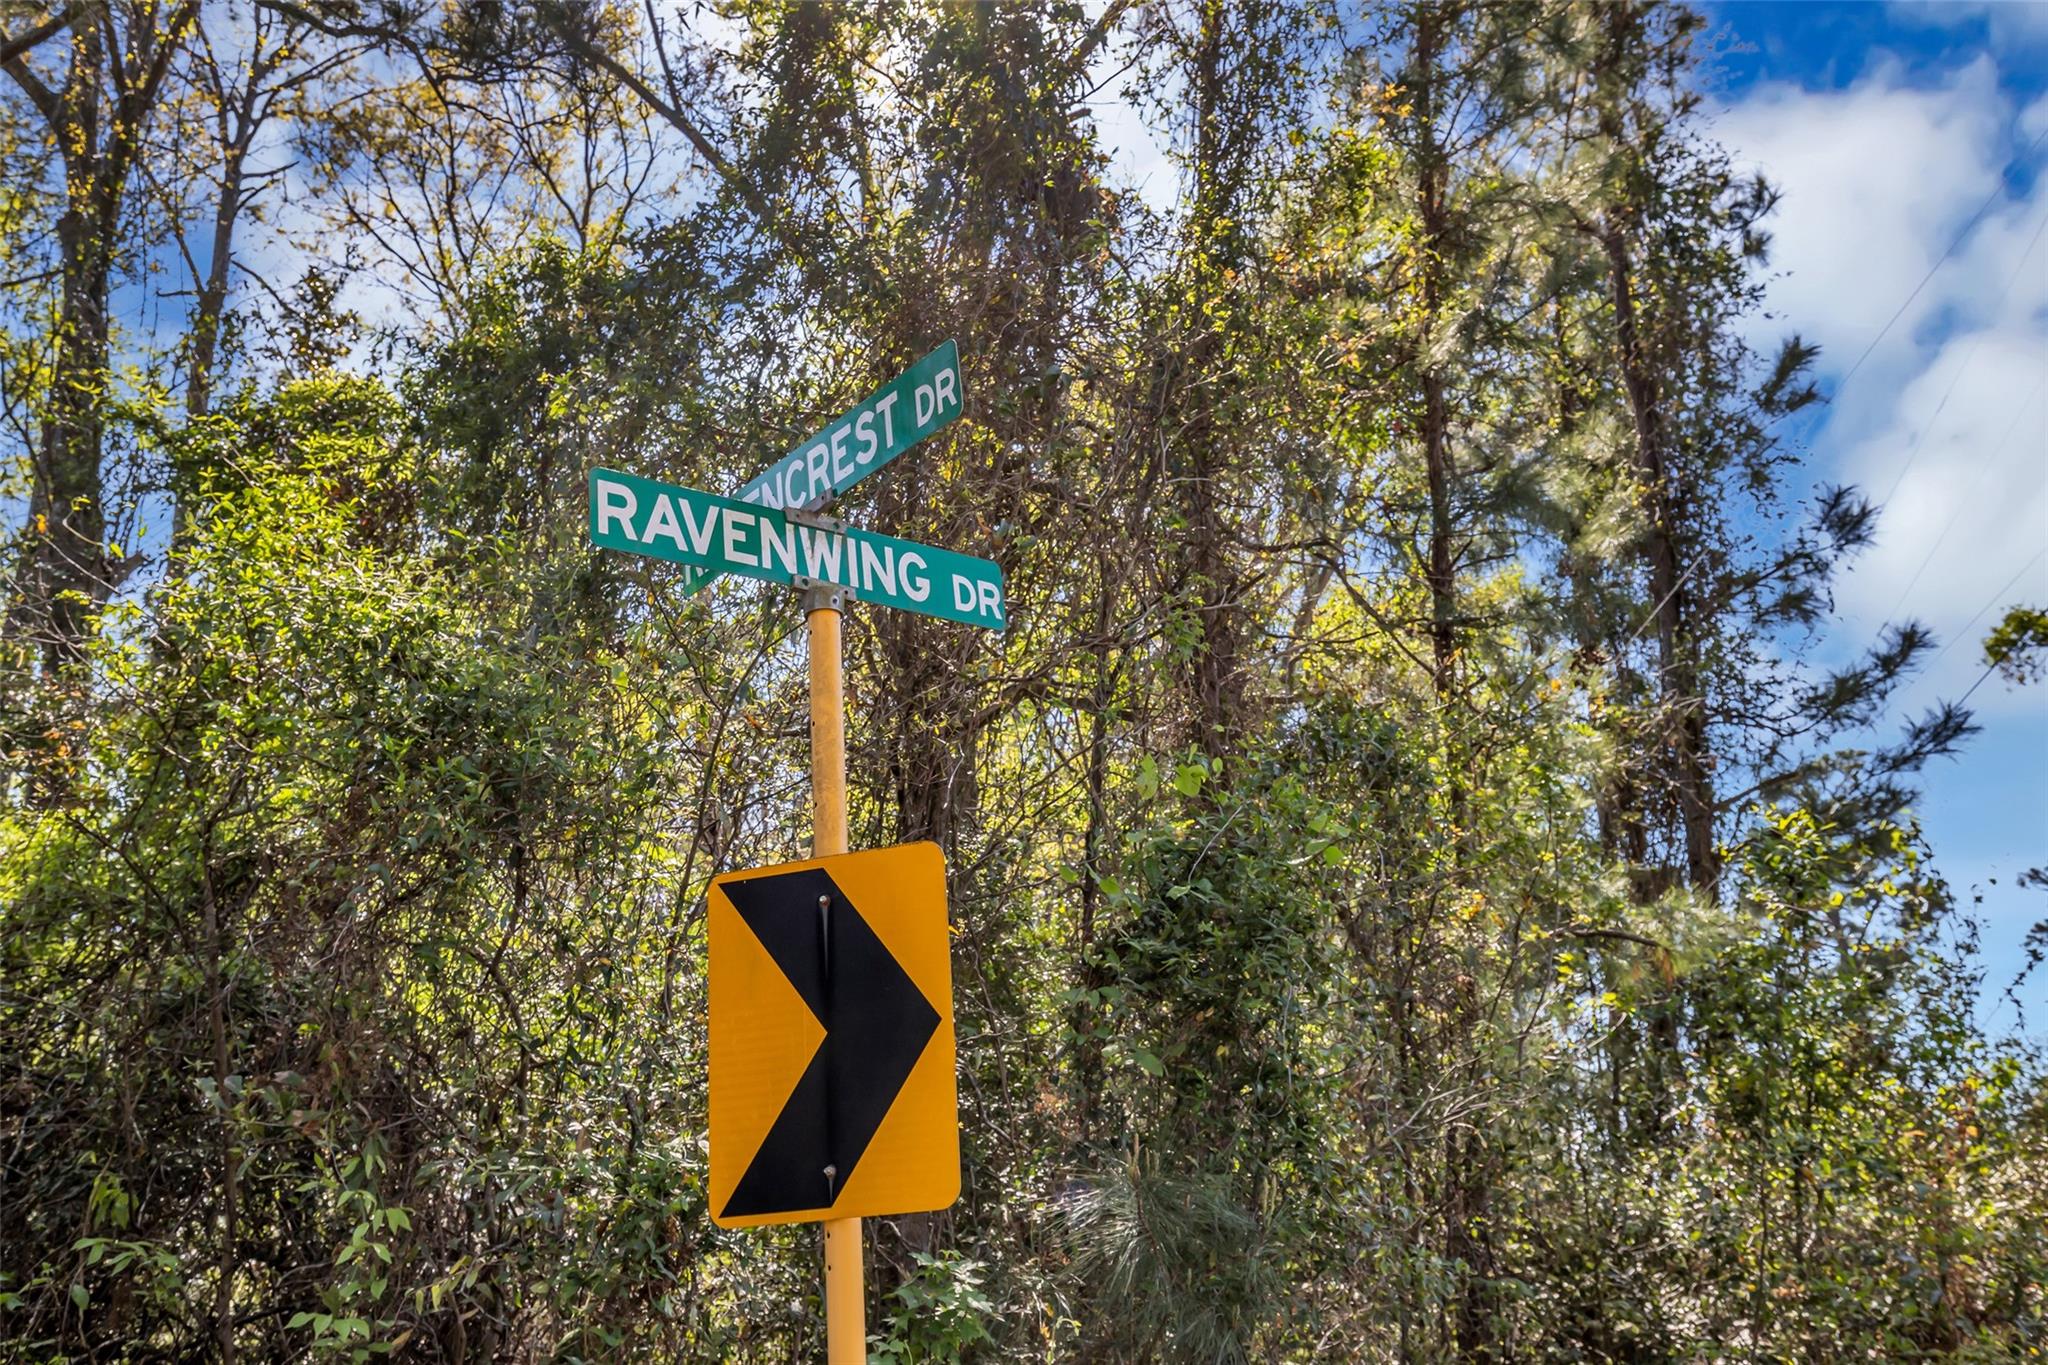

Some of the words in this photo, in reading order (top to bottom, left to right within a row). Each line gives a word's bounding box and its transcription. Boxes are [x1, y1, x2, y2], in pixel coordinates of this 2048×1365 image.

[914, 368, 958, 428] DR
[597, 480, 930, 602] RAVENWING
[952, 573, 1002, 620] DR
